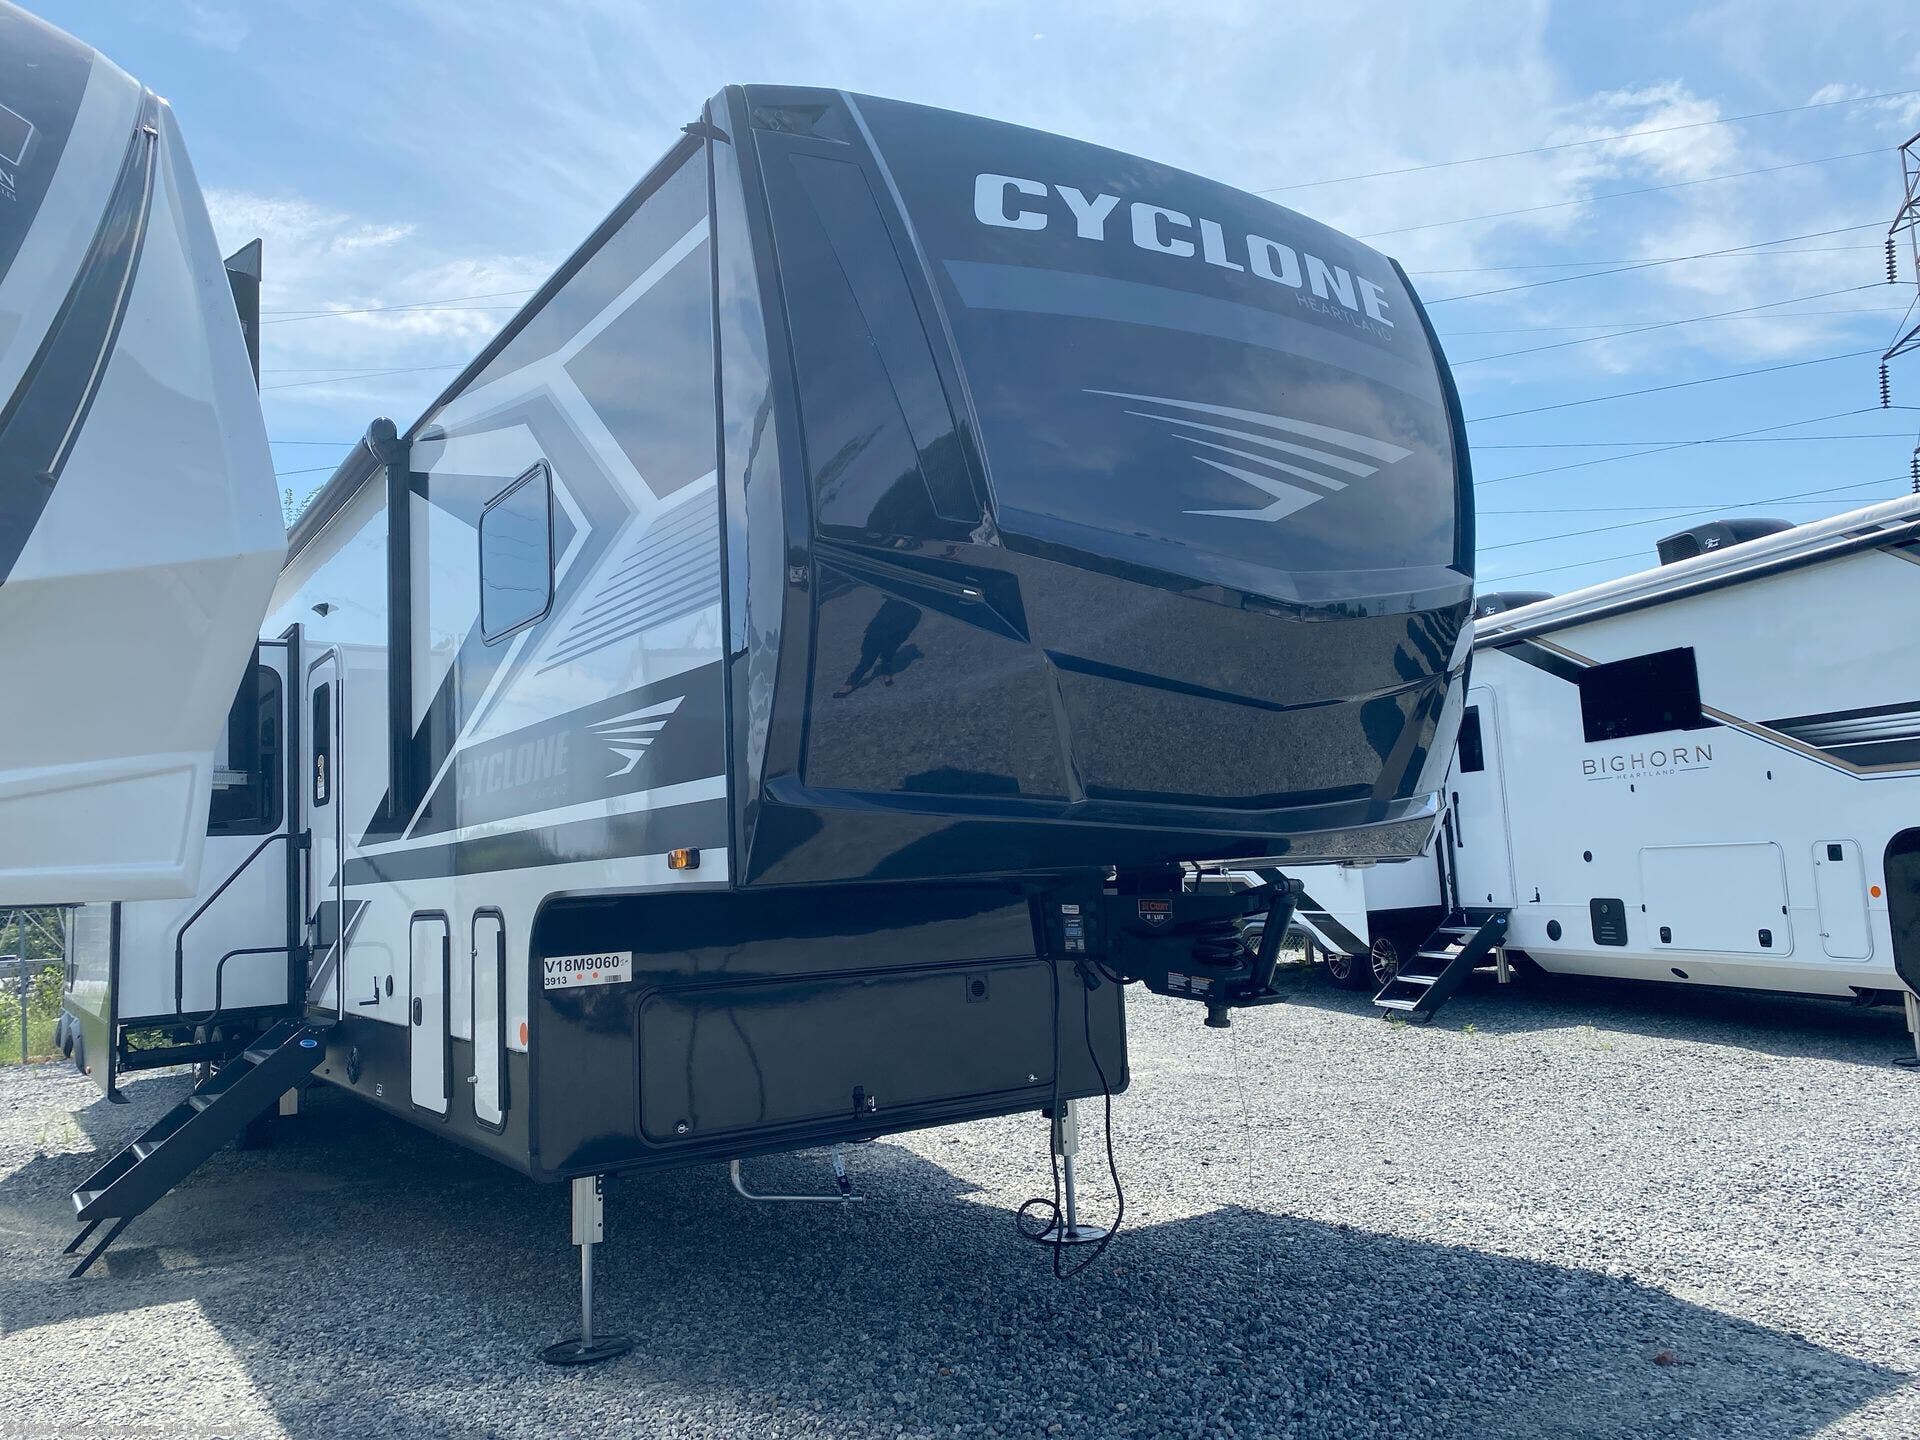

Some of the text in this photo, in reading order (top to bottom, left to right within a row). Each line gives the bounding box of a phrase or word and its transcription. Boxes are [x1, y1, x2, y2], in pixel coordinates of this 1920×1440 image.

[974, 173, 1394, 328] CYCLONE
[1294, 291, 1392, 341] HEARTLAND
[458, 731, 571, 800] CYCLONE
[1582, 744, 1713, 775] BIGHORN
[1616, 769, 1675, 780] HEARTLAND
[545, 956, 620, 974] V18M9060
[545, 976, 567, 986] 3913
